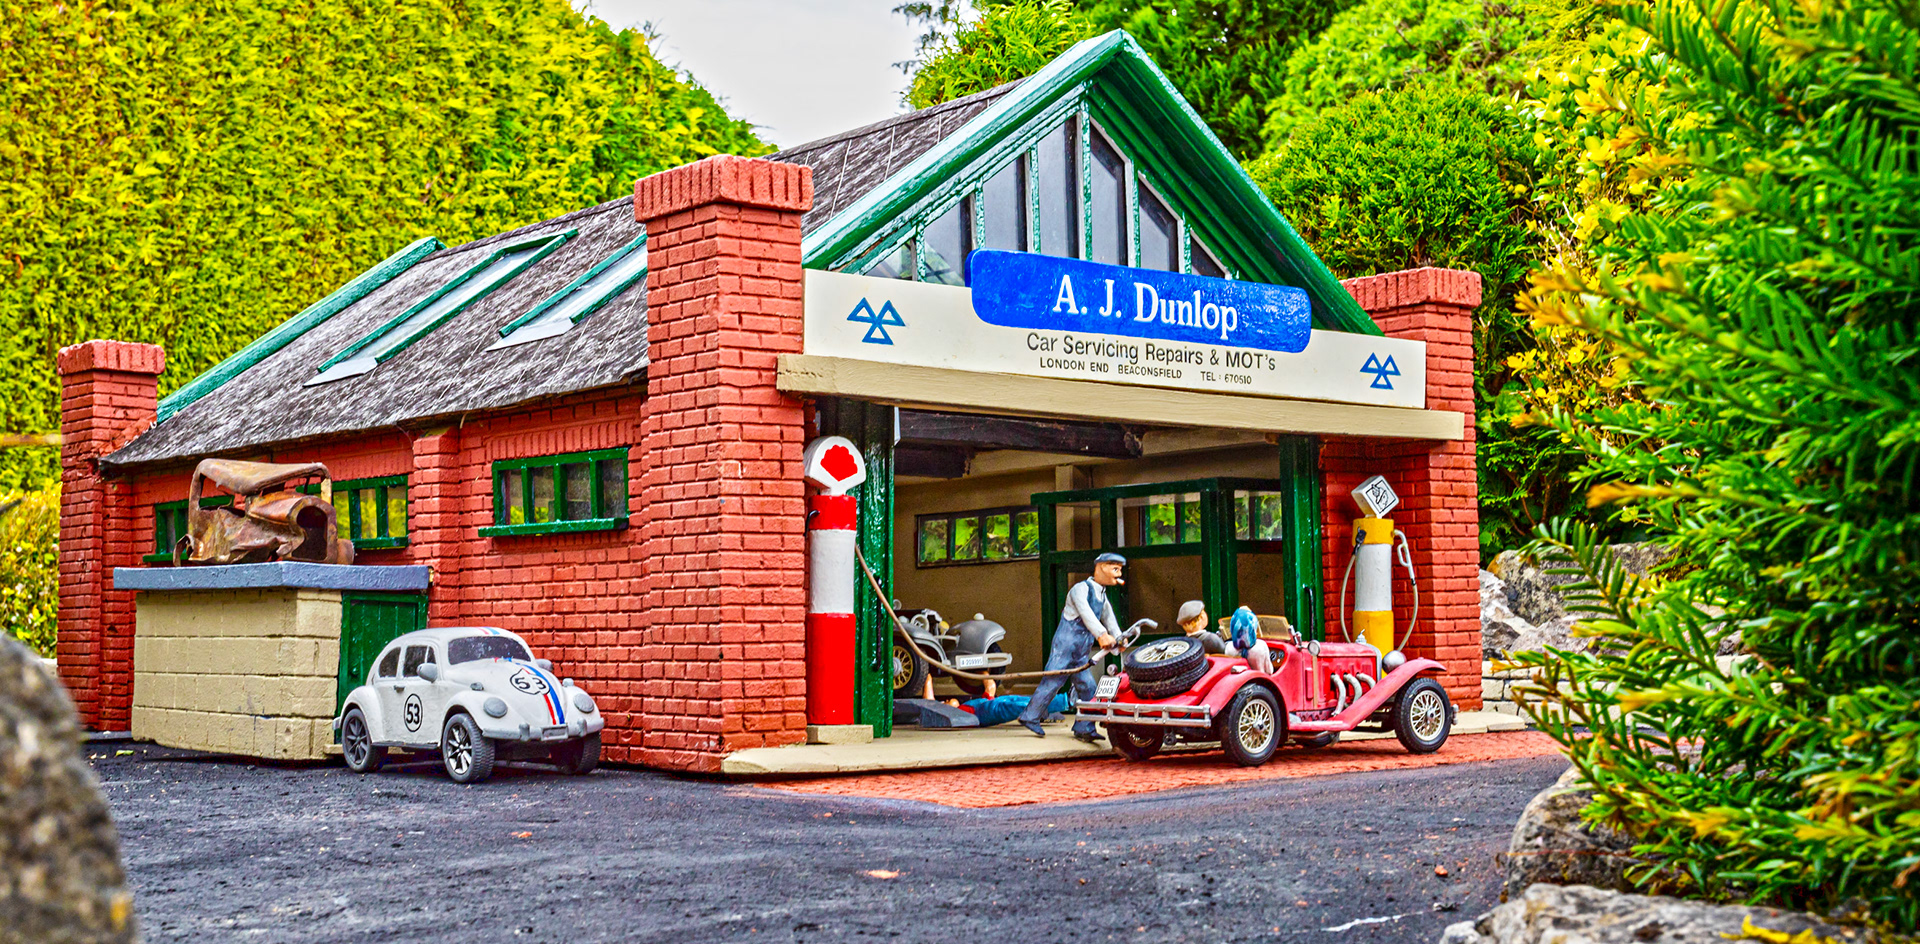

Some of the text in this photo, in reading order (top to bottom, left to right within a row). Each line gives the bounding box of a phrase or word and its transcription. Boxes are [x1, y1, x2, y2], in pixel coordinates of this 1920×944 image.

[1052, 274, 1238, 340] A. J. Dunlop
[1027, 332, 1276, 371] Car Servicing Repairs & MOT's
[1040, 357, 1085, 370] LONDON
[1090, 362, 1109, 373] END
[1118, 364, 1182, 379] BEACONSFIELD
[1224, 373, 1252, 385] 670510
[514, 676, 547, 690] 53
[406, 703, 420, 724] 53
